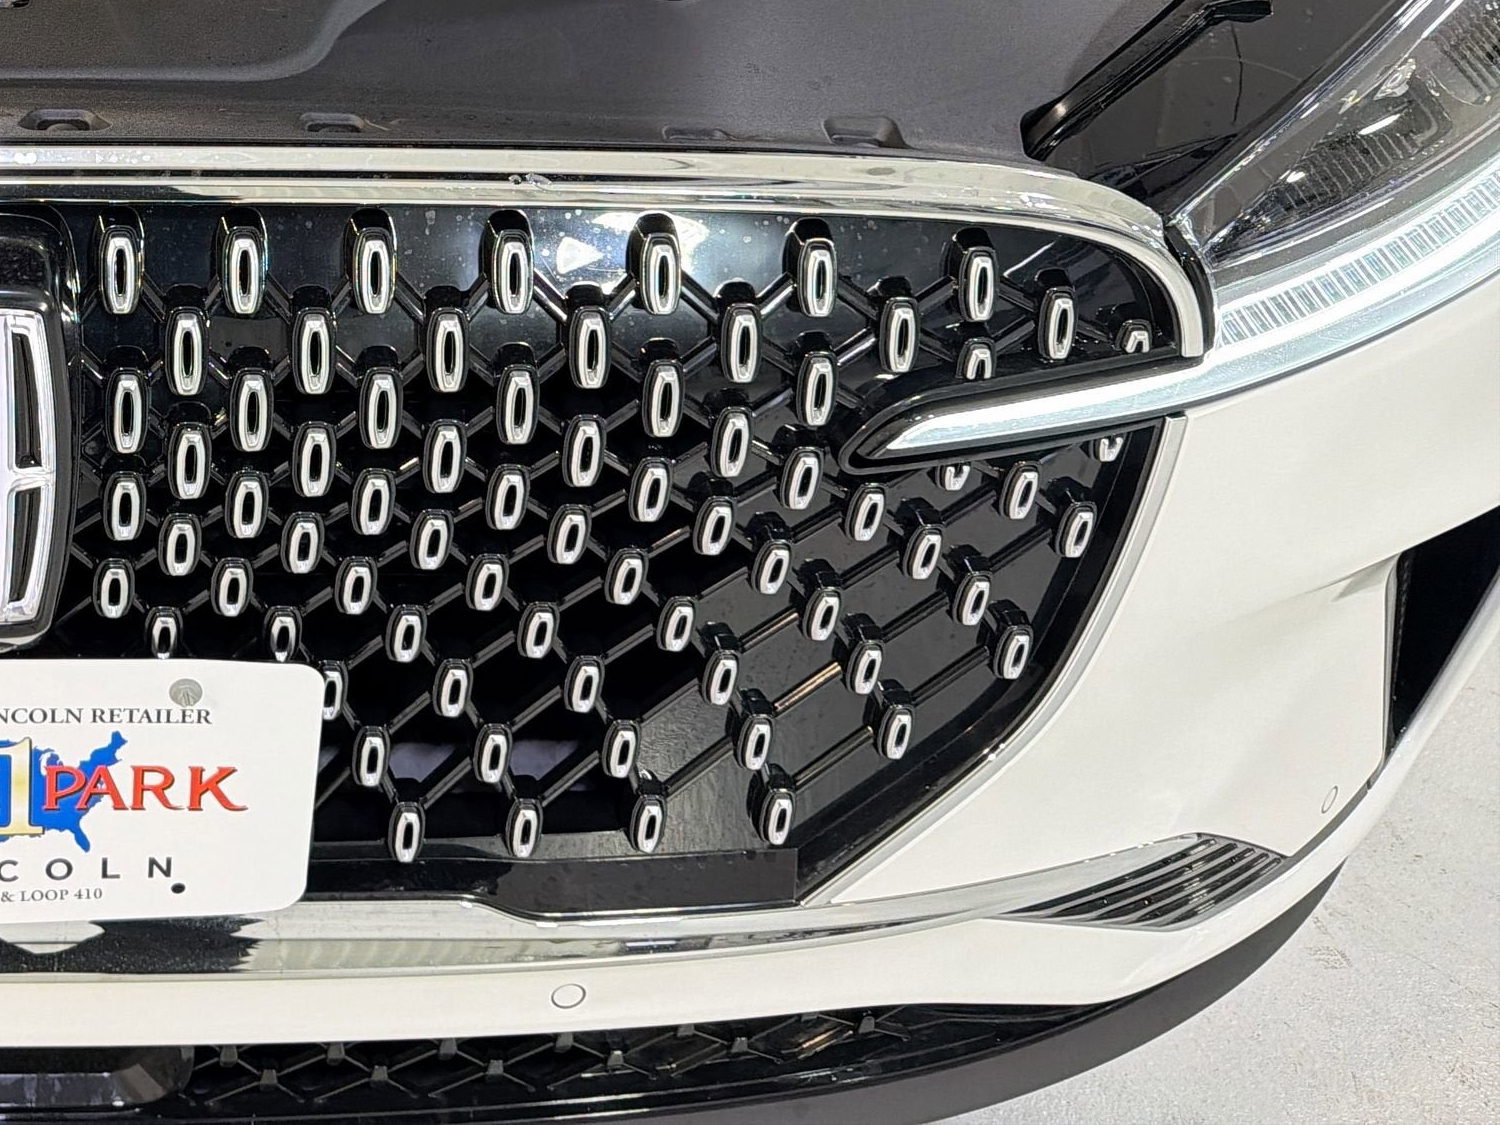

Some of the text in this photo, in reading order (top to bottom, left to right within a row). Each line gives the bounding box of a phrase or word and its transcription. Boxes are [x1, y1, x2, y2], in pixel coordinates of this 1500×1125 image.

[91, 708, 213, 725] RETAILER
[42, 765, 250, 812] PARK
[0, 890, 15, 903] &
[20, 889, 69, 902] LOOP
[74, 888, 103, 900] 410
